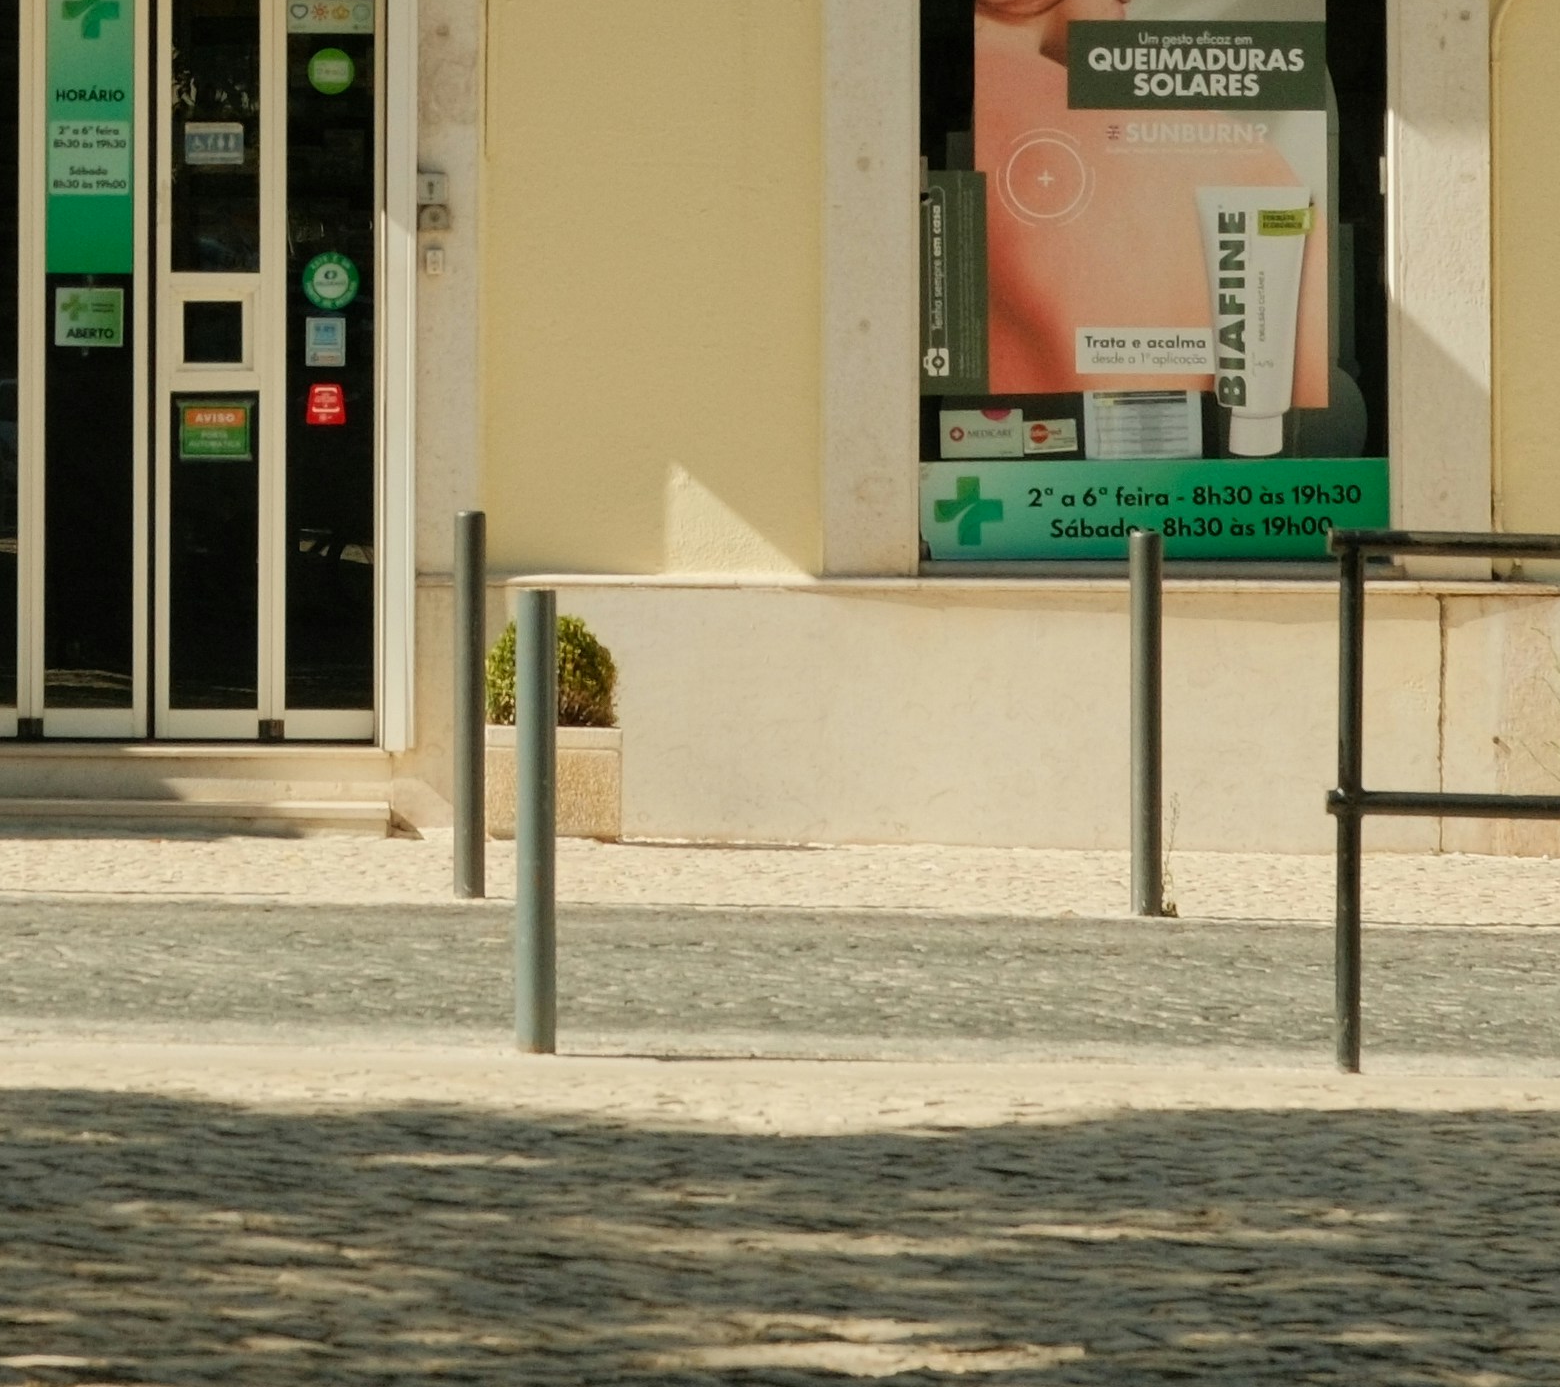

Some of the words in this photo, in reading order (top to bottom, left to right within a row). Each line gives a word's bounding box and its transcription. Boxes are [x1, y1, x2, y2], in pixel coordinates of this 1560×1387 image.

[1138, 33, 1158, 45] Um
[1162, 33, 1193, 48] gesto
[1196, 31, 1231, 45] eficaz
[1235, 36, 1252, 44] em
[1088, 47, 1305, 72] QUEIMADURAS
[56, 85, 124, 102] HORÁRIO
[1133, 73, 1260, 97] SOLARES
[1125, 124, 1268, 144] SUNBURN?
[932, 205, 941, 233] casa
[933, 236, 942, 256] em
[1218, 211, 1247, 407] BIAFINE
[66, 328, 114, 339] ABERTO
[1085, 336, 1126, 349] Trata
[1133, 339, 1142, 349] e
[1147, 335, 1206, 349] acalma
[1091, 353, 1124, 364] desde
[1128, 356, 1136, 364] a
[1152, 353, 1207, 367] aplicação
[195, 413, 235, 422] AVISO
[1027, 488, 1054, 508] 2ª
[1061, 493, 1075, 507] a
[1082, 487, 1108, 507] 6ª
[1115, 487, 1169, 507] feira
[1192, 486, 1252, 506] 8h30
[1258, 486, 1286, 506] às
[1292, 484, 1362, 505] 19h30
[1162, 519, 1222, 538] 8h30
[1230, 519, 1255, 537] às
[1262, 518, 1333, 537] 19h00
